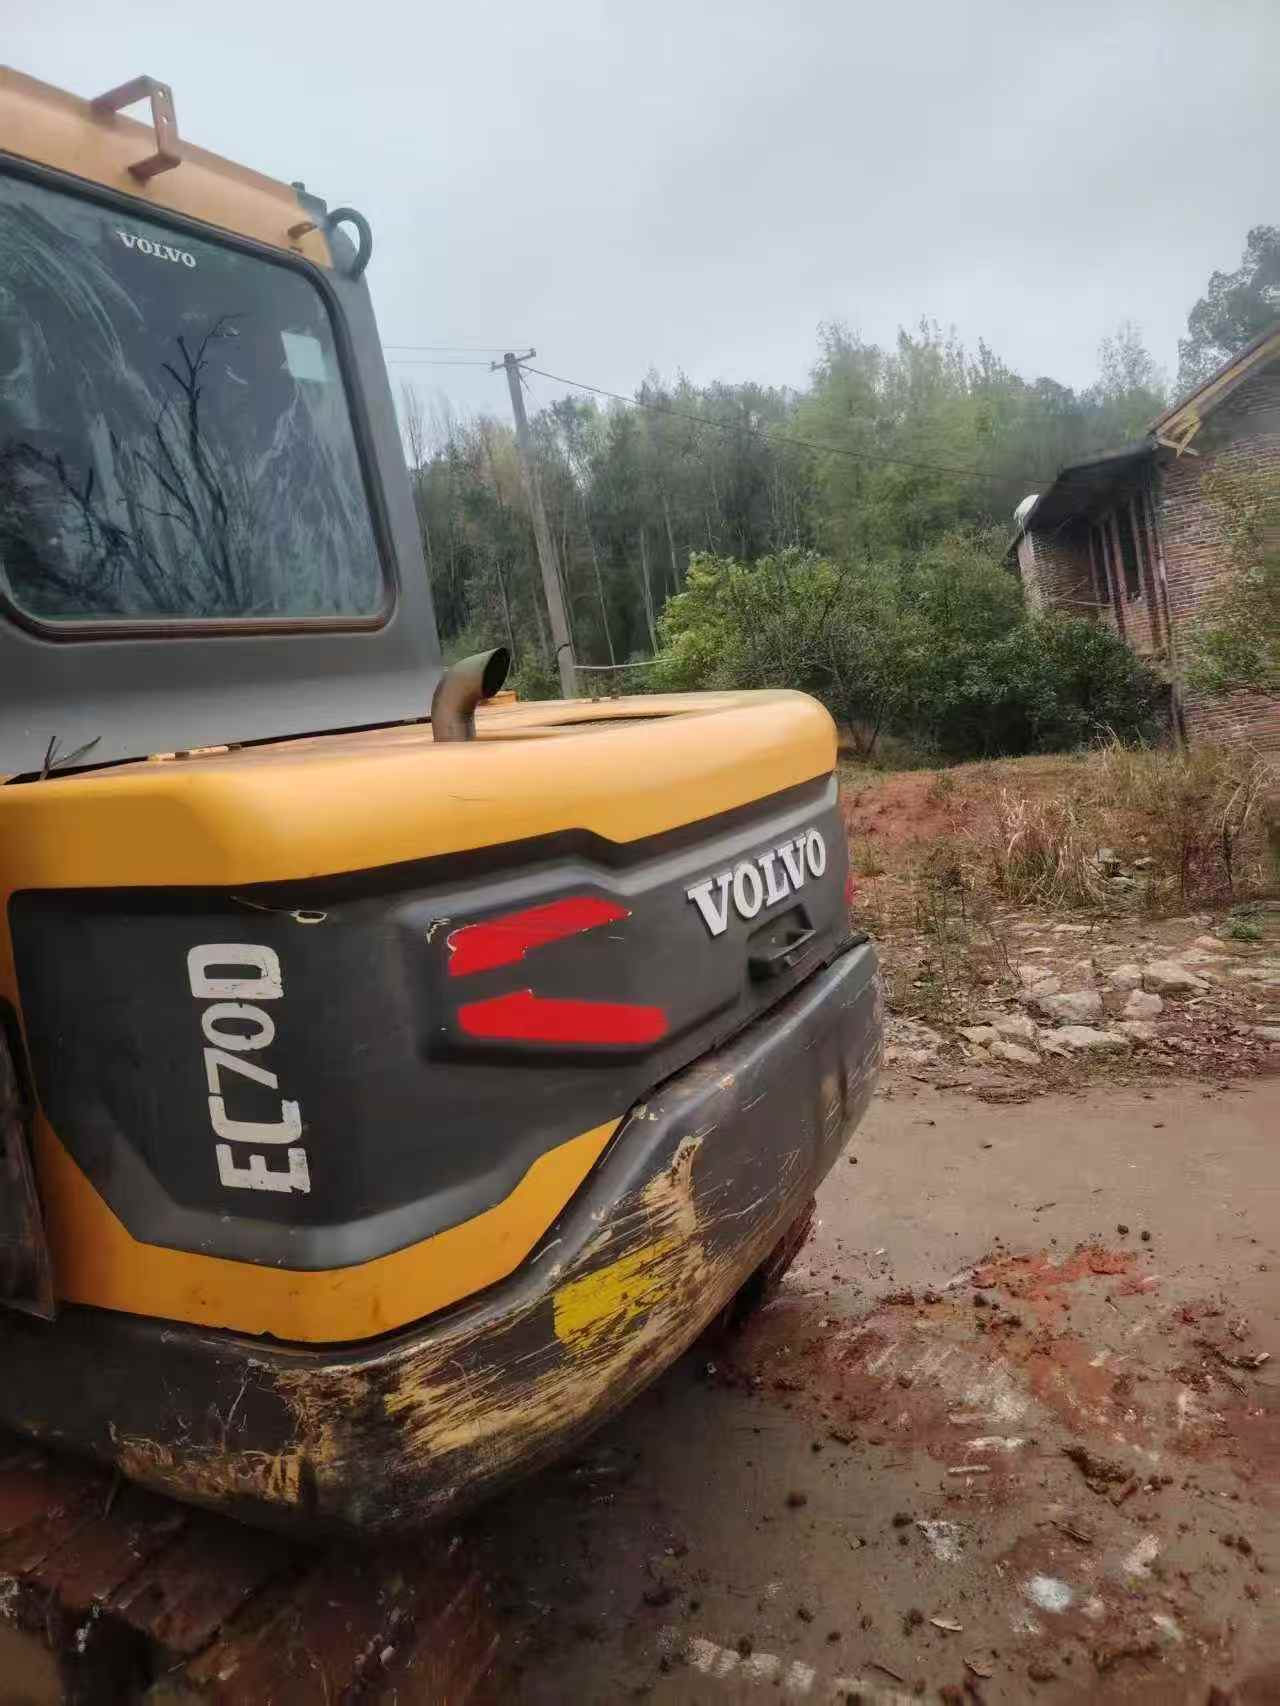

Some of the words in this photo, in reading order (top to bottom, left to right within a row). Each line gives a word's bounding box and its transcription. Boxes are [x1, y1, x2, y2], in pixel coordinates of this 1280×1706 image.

[116, 230, 197, 268] VOLVO
[686, 829, 827, 936] VOLVO
[187, 943, 311, 1194] EC70D
